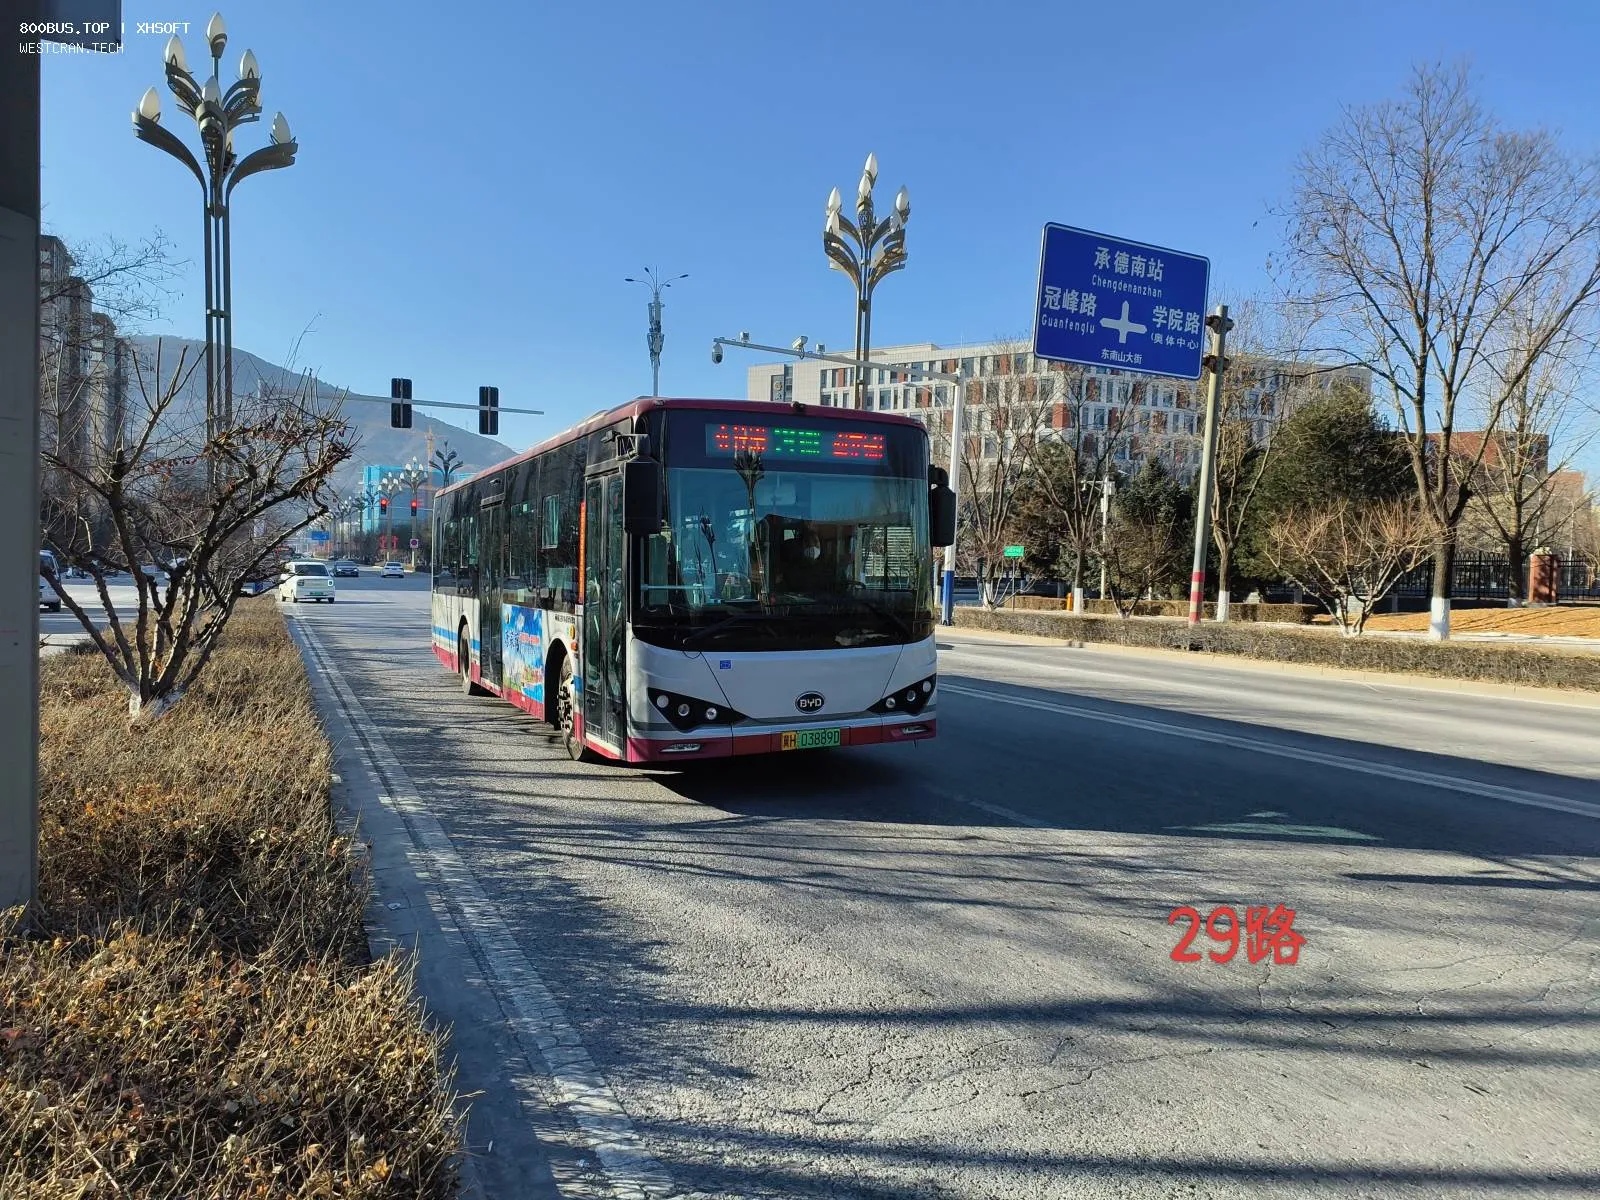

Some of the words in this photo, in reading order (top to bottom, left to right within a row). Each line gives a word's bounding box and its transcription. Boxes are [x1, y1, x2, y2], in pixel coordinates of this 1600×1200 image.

[1093, 246, 1164, 282] 承德南站
[1091, 274, 1162, 298] Chengdenanzhan
[1043, 285, 1097, 317] 冠峰路
[1041, 314, 1095, 336] Guanfenglu
[1152, 305, 1200, 334] 学院路
[1100, 348, 1142, 364] 东南山大街
[800, 698, 822, 708] BYD
